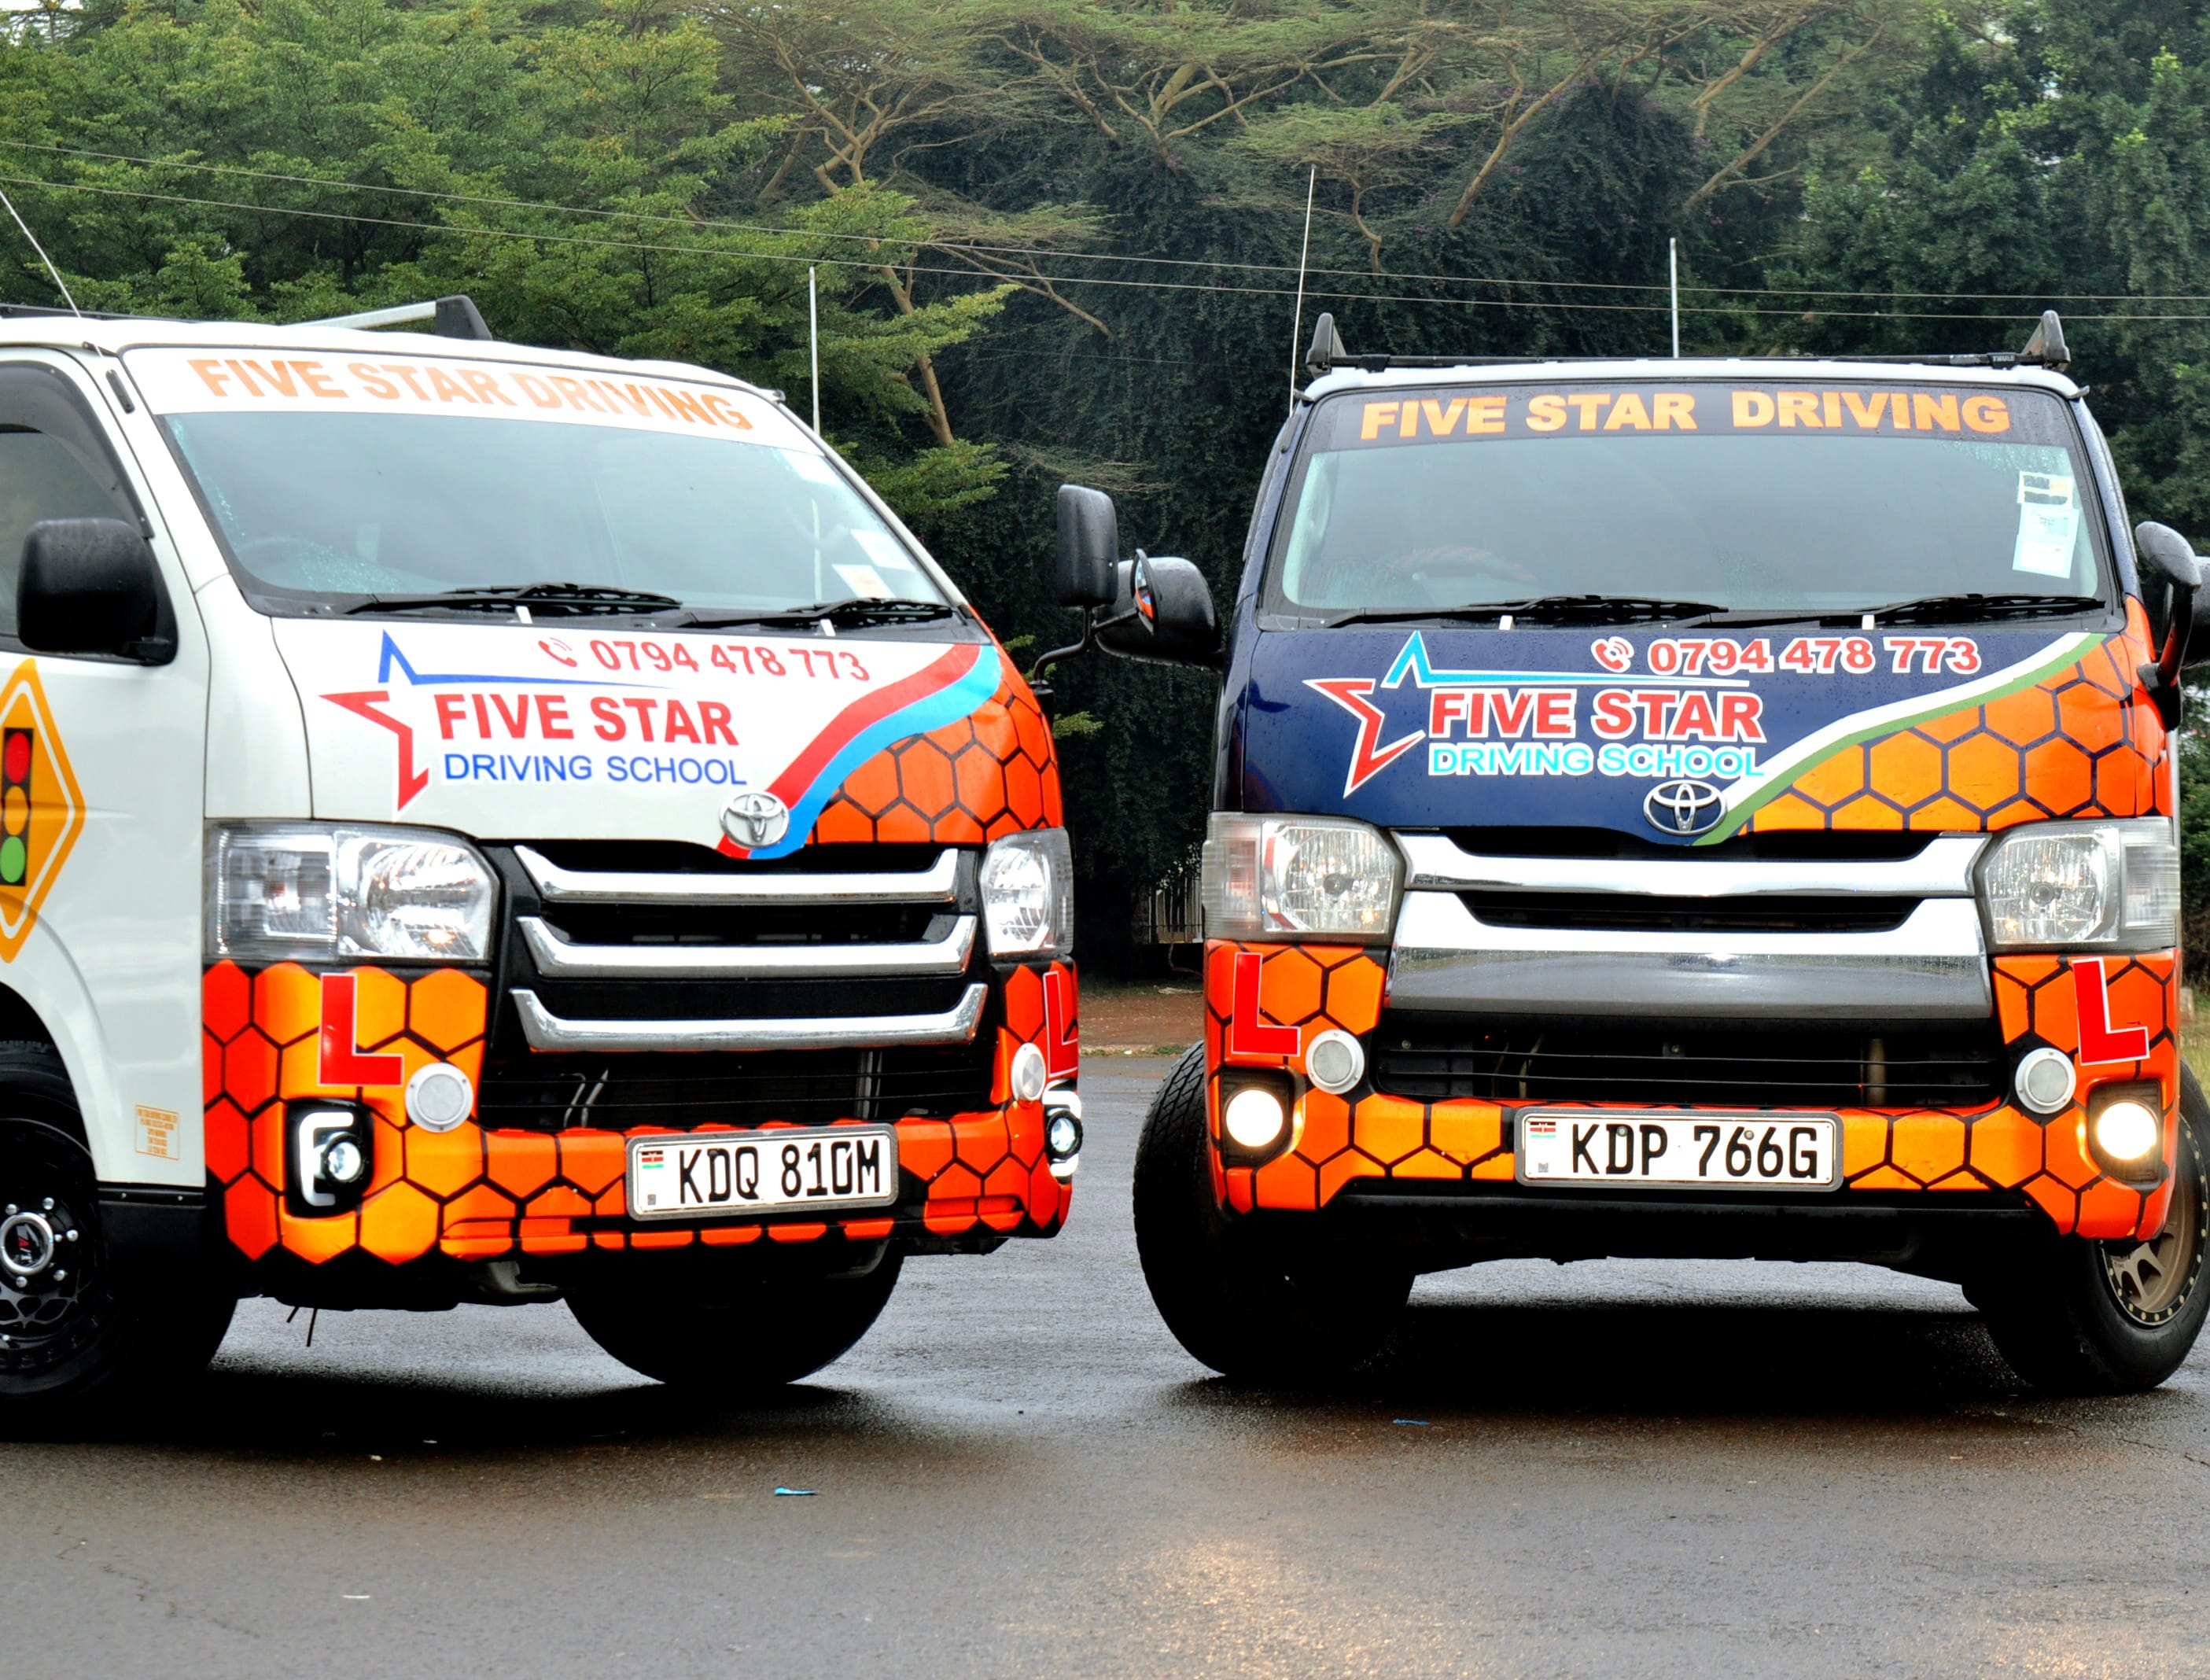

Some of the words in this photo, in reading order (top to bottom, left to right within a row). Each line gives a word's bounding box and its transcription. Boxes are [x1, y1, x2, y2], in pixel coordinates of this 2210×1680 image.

[188, 359, 348, 399] FIVE
[347, 362, 518, 407] STAR
[508, 373, 753, 430] DRIVING
[1361, 395, 1506, 440] FIVE
[1526, 392, 1698, 431] STAR
[1732, 391, 2010, 433] DRIVING
[590, 639, 699, 672] 0794
[711, 646, 786, 676] 478
[788, 649, 870, 681] 773
[1648, 639, 1775, 676] 0794
[1781, 637, 1875, 672] 478
[1884, 637, 1980, 674] 773
[433, 694, 574, 740] FIVE
[591, 695, 739, 746] STAR
[1429, 690, 1578, 738] FIVE
[1593, 689, 1767, 742] STAR
[444, 753, 592, 781] DRIVING
[606, 756, 747, 786] SCHOOL
[1427, 742, 1591, 776] DRIVING
[1597, 743, 1765, 779] SCHOOL
[318, 973, 403, 1087] L
[1232, 952, 1300, 1056] L
[2072, 957, 2149, 1066] L
[680, 1146, 759, 1204] KDQ
[1573, 1123, 1667, 1175] KDP
[1693, 1125, 1817, 1179] 766G
